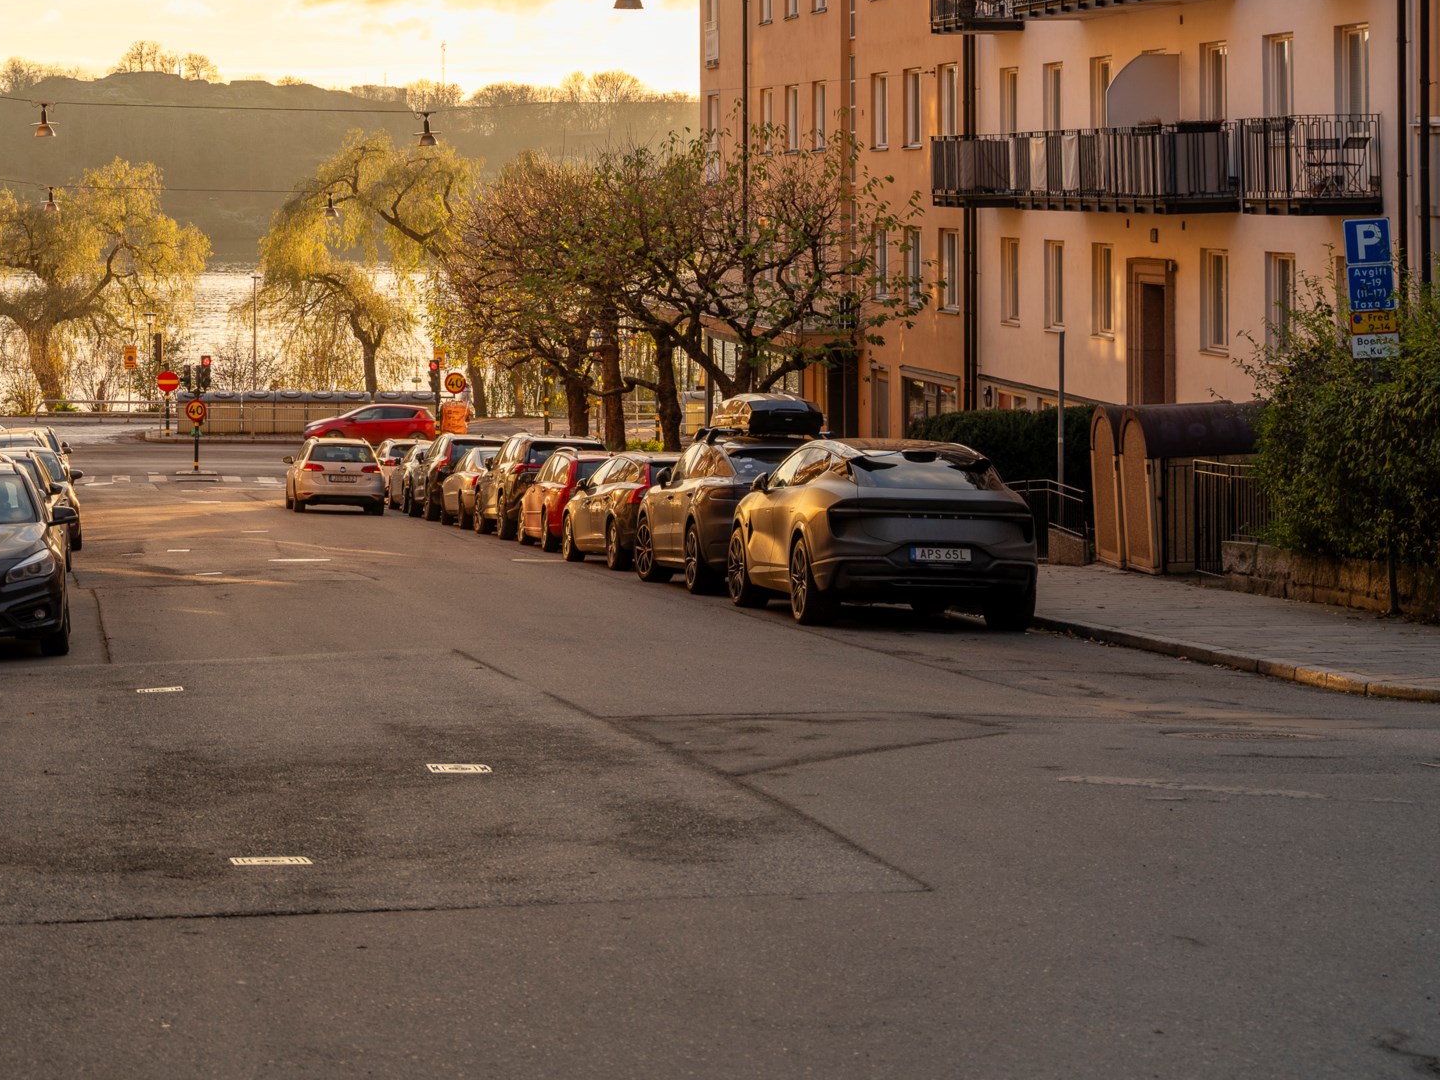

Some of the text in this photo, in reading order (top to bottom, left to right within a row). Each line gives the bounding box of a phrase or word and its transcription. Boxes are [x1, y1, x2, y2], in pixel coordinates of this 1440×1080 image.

[1355, 223, 1382, 260] P
[1354, 267, 1387, 278] Avgift
[1354, 299, 1391, 309] Taxa 3
[1368, 313, 1390, 322] Fred
[447, 378, 463, 389] 40
[189, 404, 203, 416] 40
[920, 548, 967, 561] APS 65L
